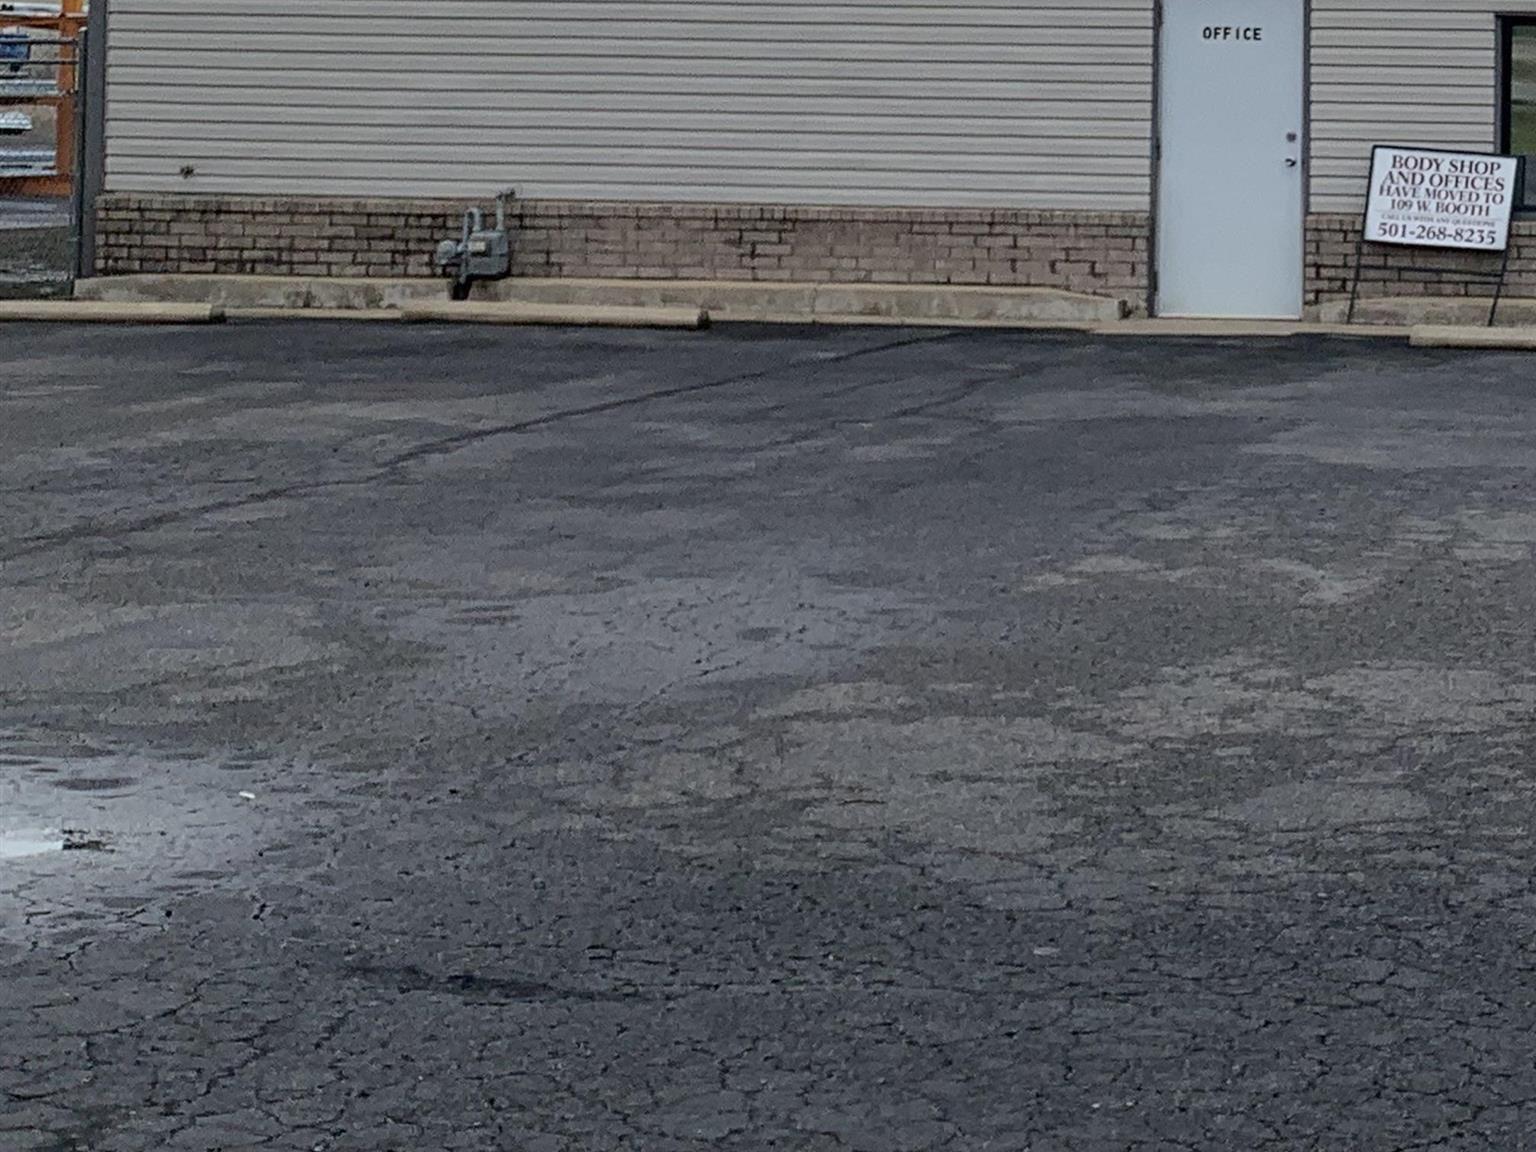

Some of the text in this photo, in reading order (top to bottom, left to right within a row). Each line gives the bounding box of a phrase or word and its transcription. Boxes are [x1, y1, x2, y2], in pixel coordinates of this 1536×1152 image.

[1202, 26, 1262, 41] OFFICE
[1392, 154, 1501, 175] BODY SHOP
[1381, 170, 1505, 192] AND OFFICES
[1378, 185, 1504, 205] HAVE MOVED TO
[1436, 202, 1490, 216] BOOTH
[1378, 222, 1497, 245] 501-268-8235
